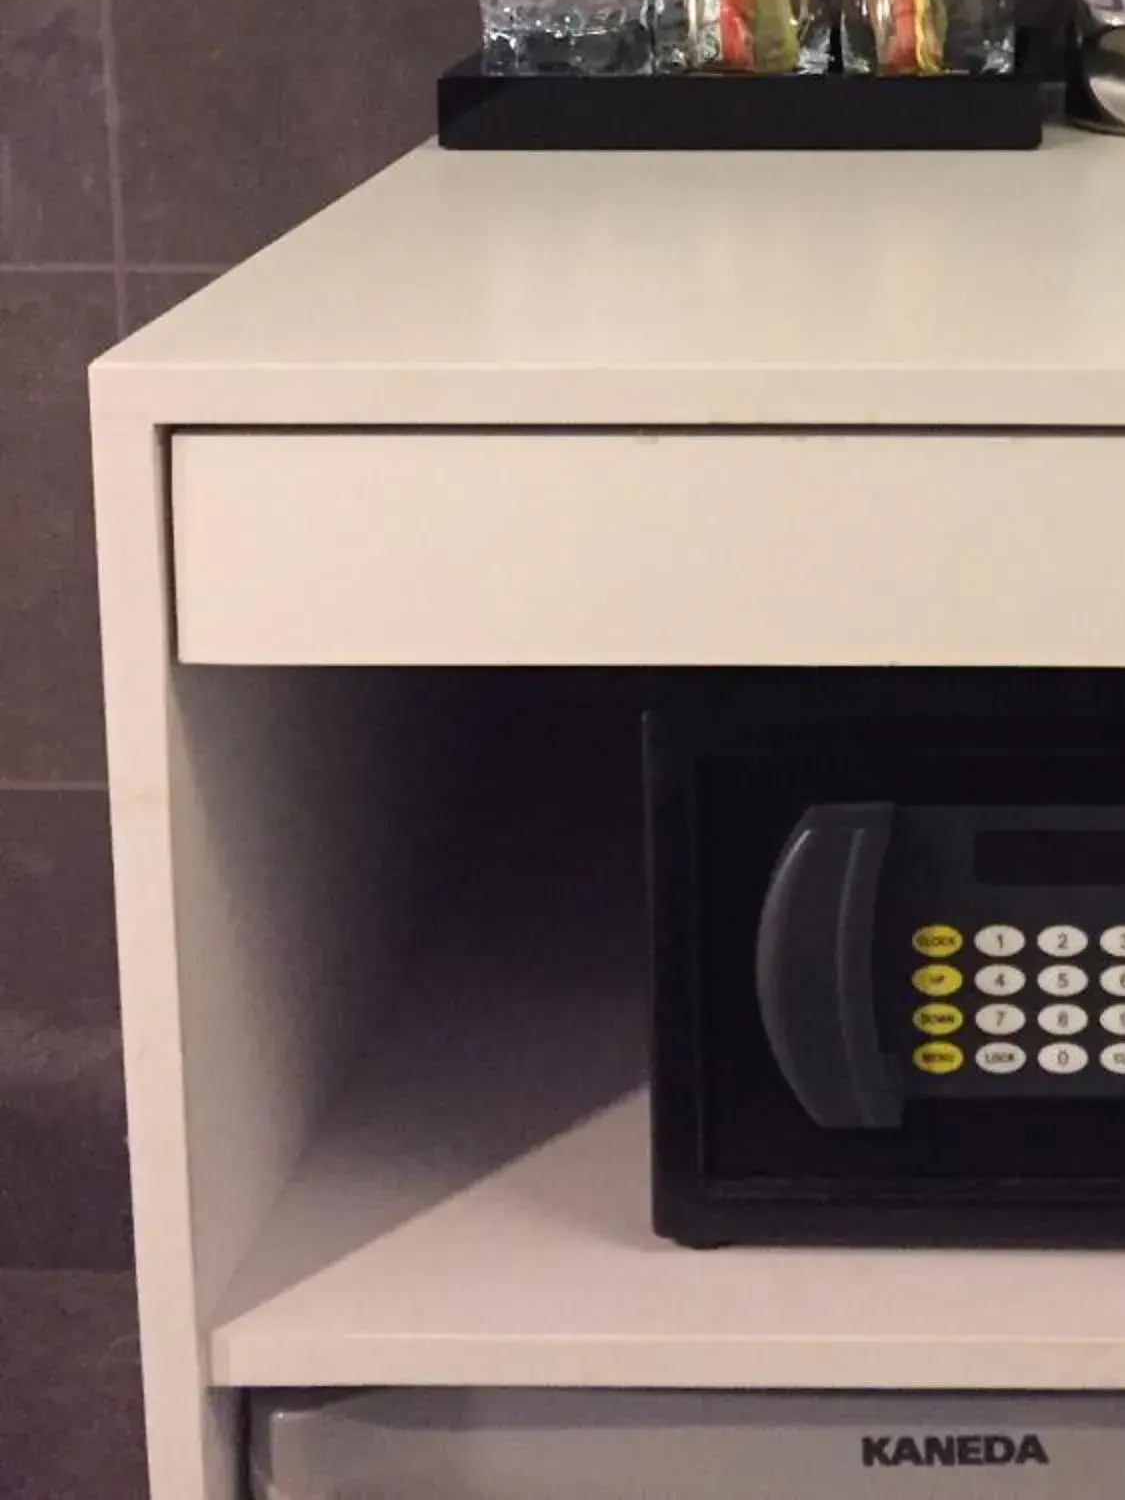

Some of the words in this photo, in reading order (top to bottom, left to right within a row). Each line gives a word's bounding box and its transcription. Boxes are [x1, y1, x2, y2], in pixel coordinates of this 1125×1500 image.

[996, 933, 1004, 949] 1
[1057, 933, 1068, 949] 2
[995, 973, 1005, 988] 4
[1057, 973, 1068, 989] 5
[996, 1011, 1005, 1027] 7
[1057, 1011, 1069, 1028] 8
[984, 1051, 1015, 1064] LOCK
[1057, 1050, 1069, 1066] 0
[861, 1434, 1050, 1466] KANEDA
